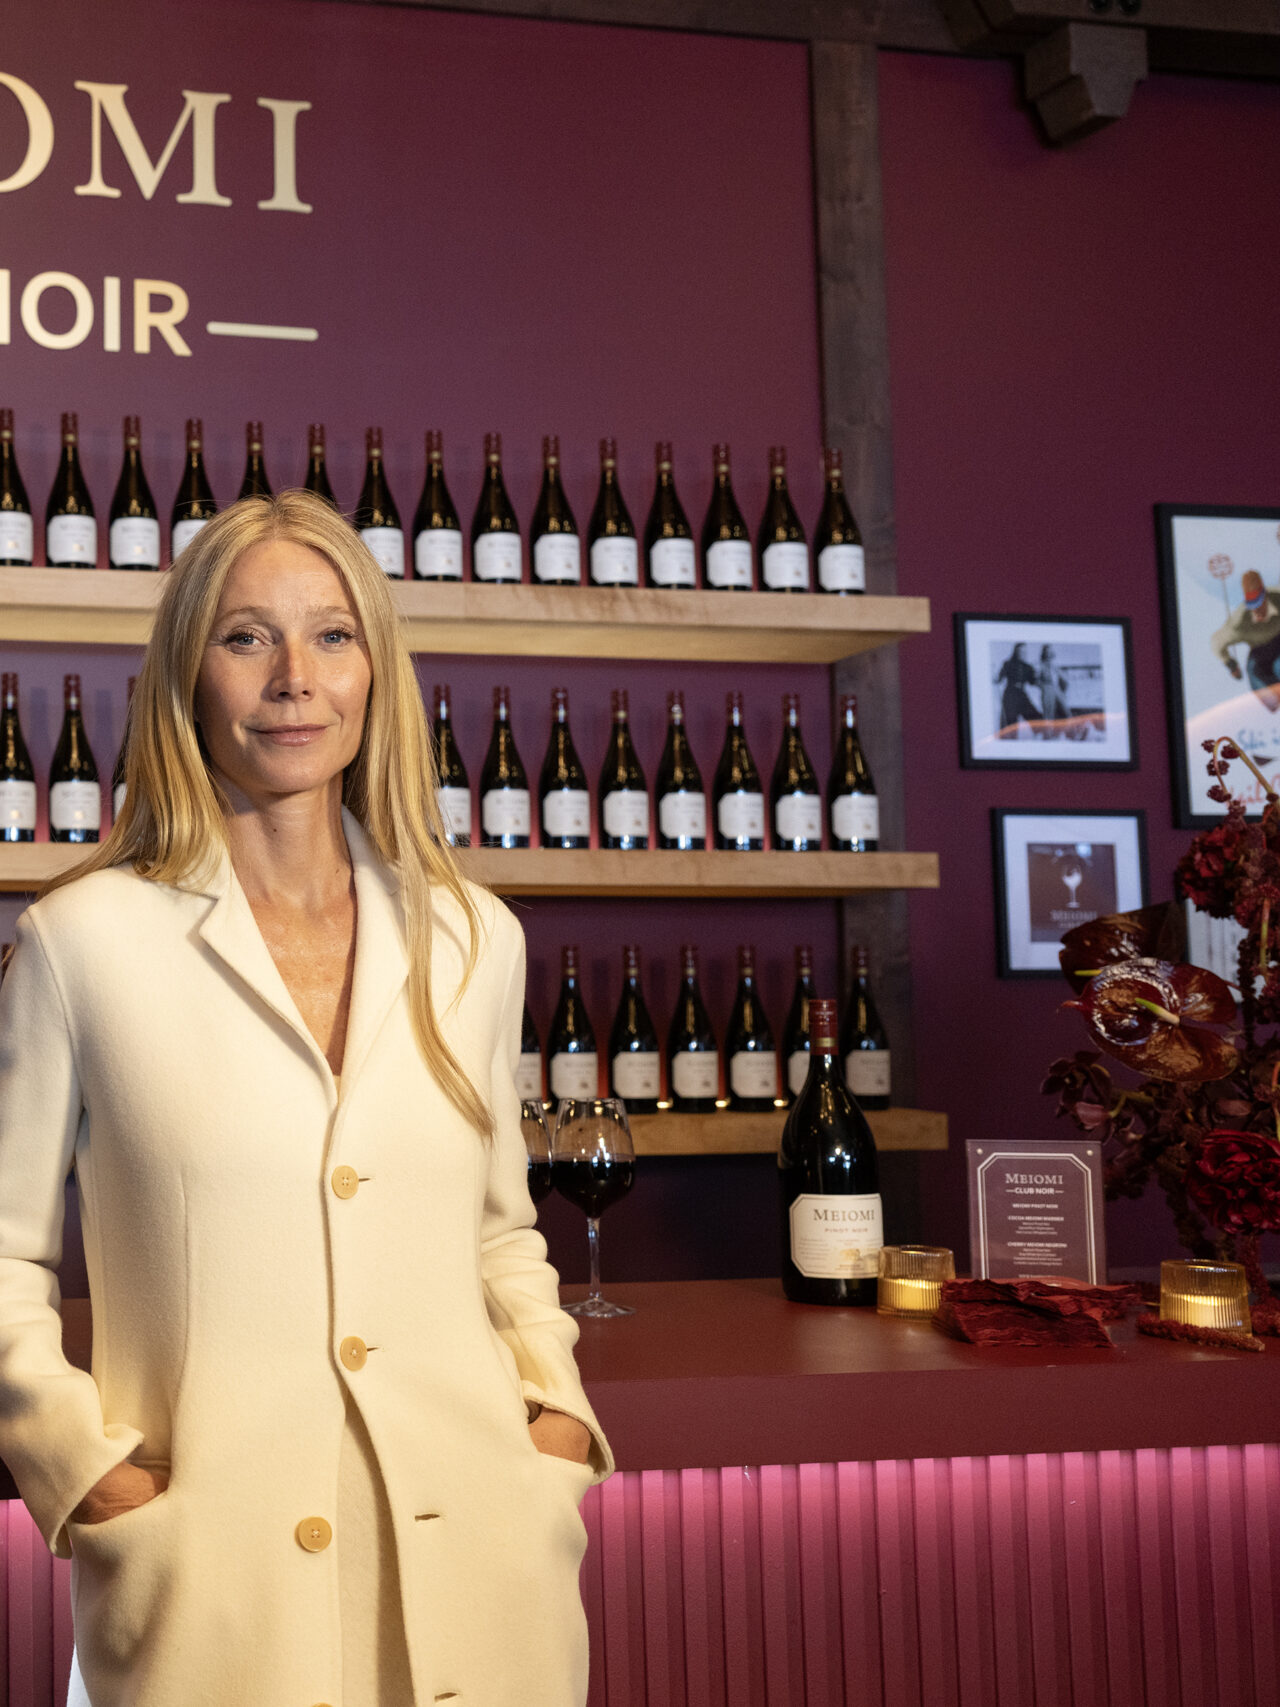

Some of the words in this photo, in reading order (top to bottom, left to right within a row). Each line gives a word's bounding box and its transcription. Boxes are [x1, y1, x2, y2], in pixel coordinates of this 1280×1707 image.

[1005, 1173, 1064, 1185] MEIOMI
[1015, 1187, 1034, 1195] CLUB
[813, 1208, 875, 1222] MEIOMI
